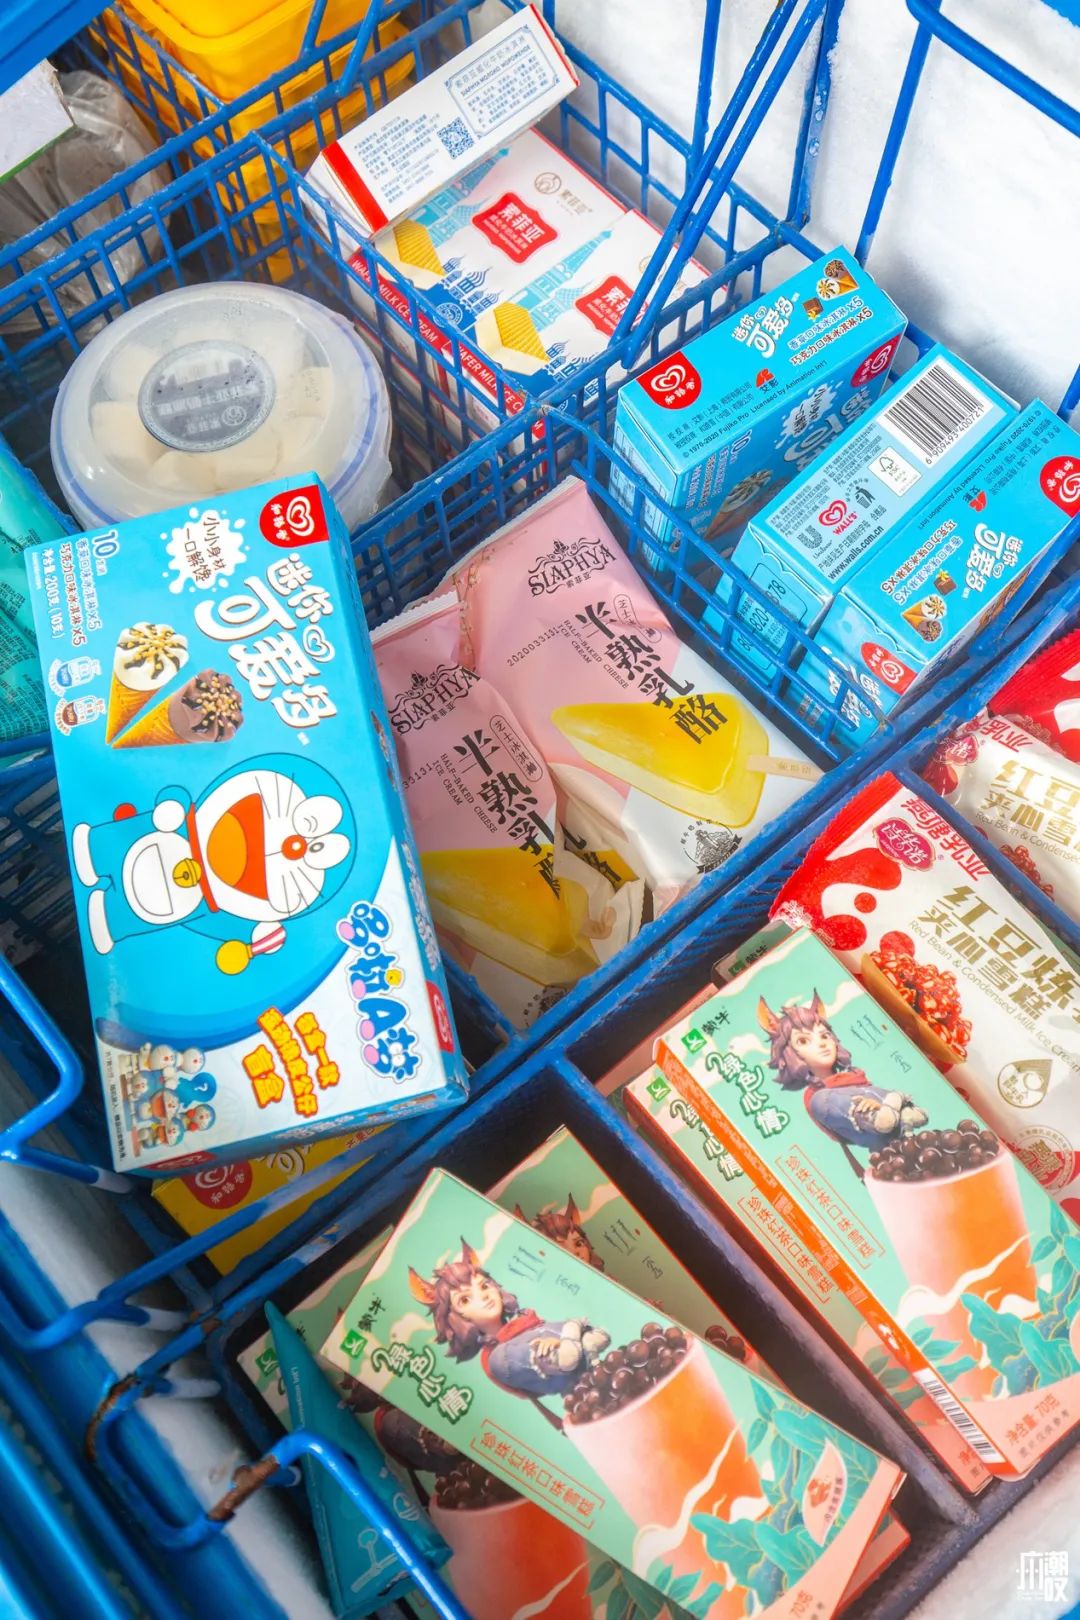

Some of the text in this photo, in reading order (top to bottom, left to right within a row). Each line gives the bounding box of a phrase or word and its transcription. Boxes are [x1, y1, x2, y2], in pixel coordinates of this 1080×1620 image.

[497, 202, 545, 243] 索菲亚
[379, 284, 397, 305] MILK
[396, 303, 410, 319] ICE
[787, 306, 850, 350] 香草口味冰淇淋
[789, 318, 859, 367] 巧克力口味冰淇淋
[664, 380, 696, 405] 和路雪
[688, 430, 720, 453] 1970-2020
[718, 418, 738, 436] Fujiko
[737, 411, 750, 423] Pro
[750, 395, 779, 414] Licensed
[777, 387, 787, 399] by
[785, 369, 816, 390] Animation
[960, 463, 985, 486] Licensed
[983, 453, 997, 465] Pro
[1046, 460, 1076, 491] 和路雪
[203, 516, 227, 572] 小小身材
[270, 503, 290, 542] 和路雪
[828, 526, 884, 580] www.walls.com.cn
[832, 513, 858, 535] WALL'S
[897, 519, 957, 581] 巧克力口味冰淇淋
[60, 543, 83, 629] 巧克力口味冰淇淋
[75, 537, 98, 611] 香草口味冰淇淋
[184, 528, 213, 583] 一口解馋
[267, 553, 334, 623] 迷你
[194, 575, 338, 729] 可爱多
[564, 620, 630, 689] HALF-BAKED CHEESE
[571, 640, 593, 664] CREAM
[575, 601, 728, 745] 半熟乳酪
[494, 719, 539, 777] 芝士冰淇淋
[433, 760, 464, 807] ICE CREAM
[440, 753, 499, 834] HALF-BAKED CHEESE
[901, 797, 993, 882] 燕塘乳业
[1029, 835, 1080, 865] Condense
[908, 920, 927, 941] Red
[926, 936, 952, 961] Bean
[952, 958, 962, 970] &
[960, 966, 1018, 1014] Condensed
[1013, 1009, 1038, 1034] Milk
[1035, 1030, 1052, 1048] Ice
[918, 905, 1053, 1022] 夹心雪糕
[936, 885, 1080, 1025] 红豆炼
[338, 902, 420, 1081] 哆啦A梦
[702, 1011, 730, 1037] 蒙牛
[242, 1045, 285, 1108] 盲盒
[706, 1052, 790, 1139] 绿色心情
[211, 1172, 245, 1204] 和路雪
[785, 1155, 875, 1257] 珍珠红茶口味雪糕
[748, 1196, 834, 1294] 珍珠红茶口味雪糕
[371, 1342, 473, 1425] 绿色心情
[480, 1432, 596, 1517] 珍珠红茶口味雪糕
